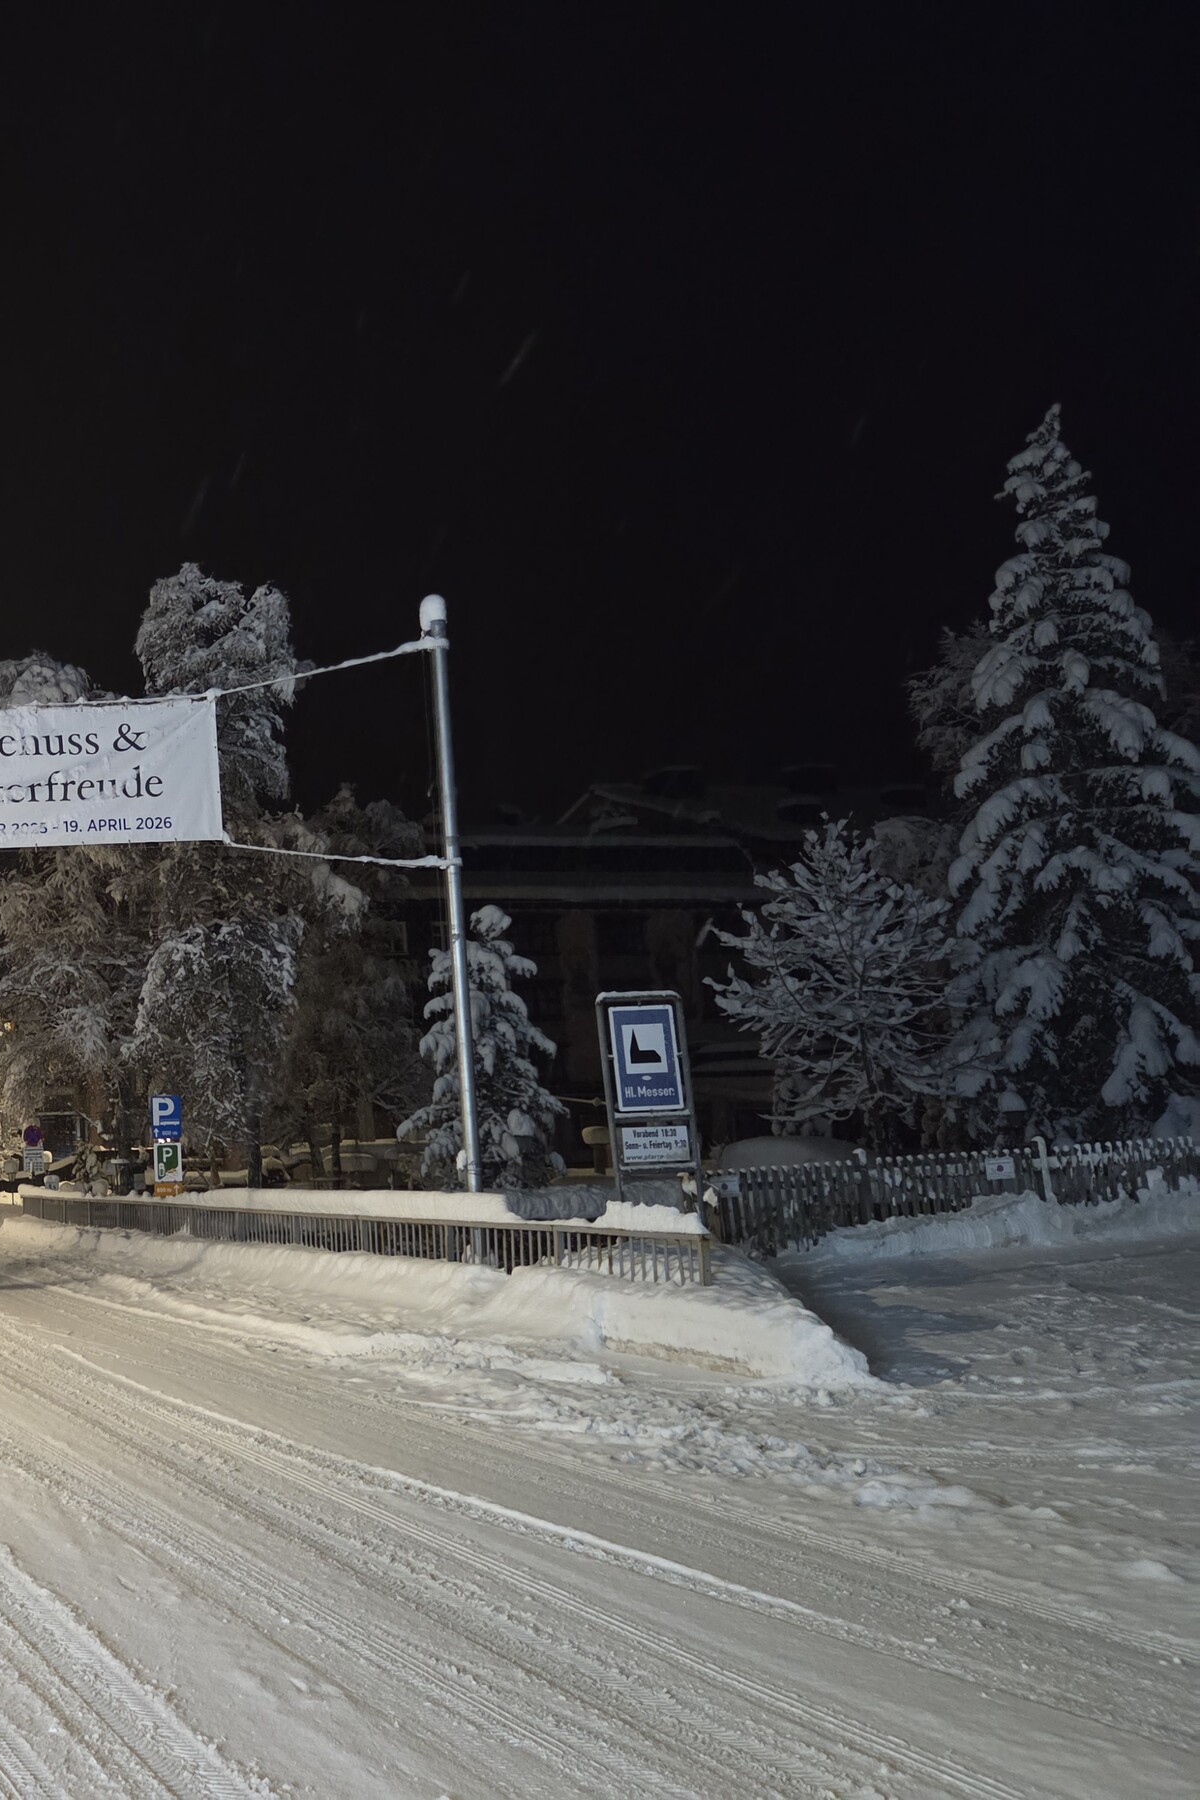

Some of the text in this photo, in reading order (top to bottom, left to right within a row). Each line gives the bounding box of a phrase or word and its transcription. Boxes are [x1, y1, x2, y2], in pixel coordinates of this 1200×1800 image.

[113, 723, 147, 751] &
[63, 820, 82, 833] 19.
[87, 818, 131, 832] APRIL
[136, 817, 173, 830] 2026
[152, 1097, 175, 1126] P
[632, 1129, 659, 1138] Vorabend
[649, 1140, 672, 1151] Feiertag
[163, 1147, 172, 1162] P
